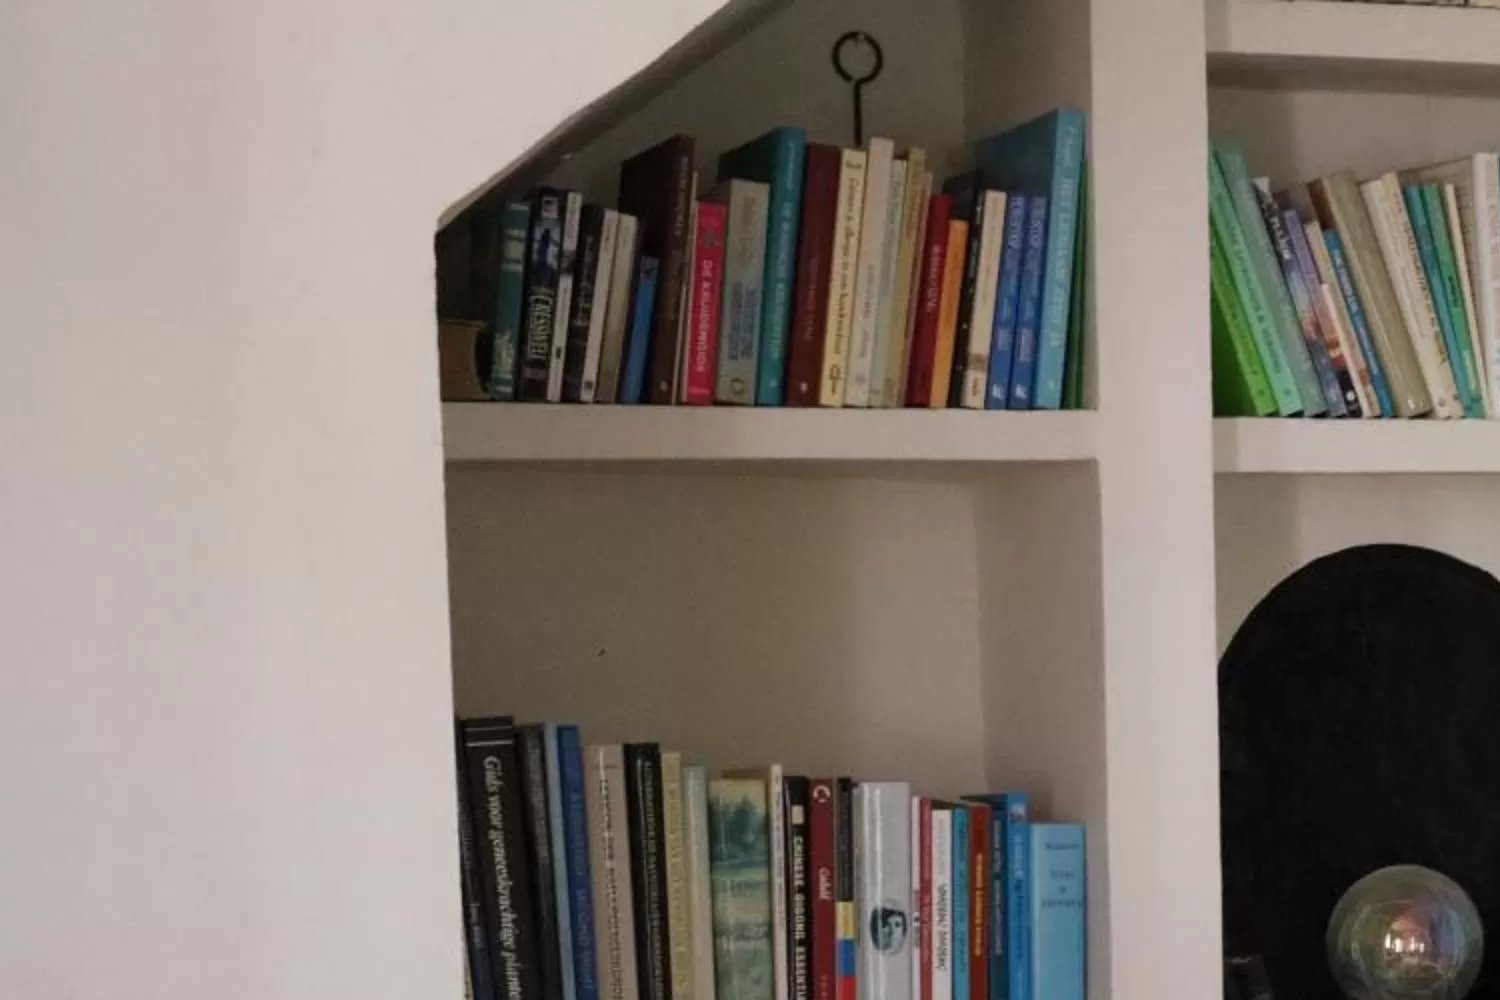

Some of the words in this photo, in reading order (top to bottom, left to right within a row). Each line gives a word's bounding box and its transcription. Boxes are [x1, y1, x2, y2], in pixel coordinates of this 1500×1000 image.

[484, 757, 502, 793] Gids
[488, 796, 505, 827] voor
[794, 836, 805, 887] CHINESE
[489, 829, 519, 949] geneeskrachtige
